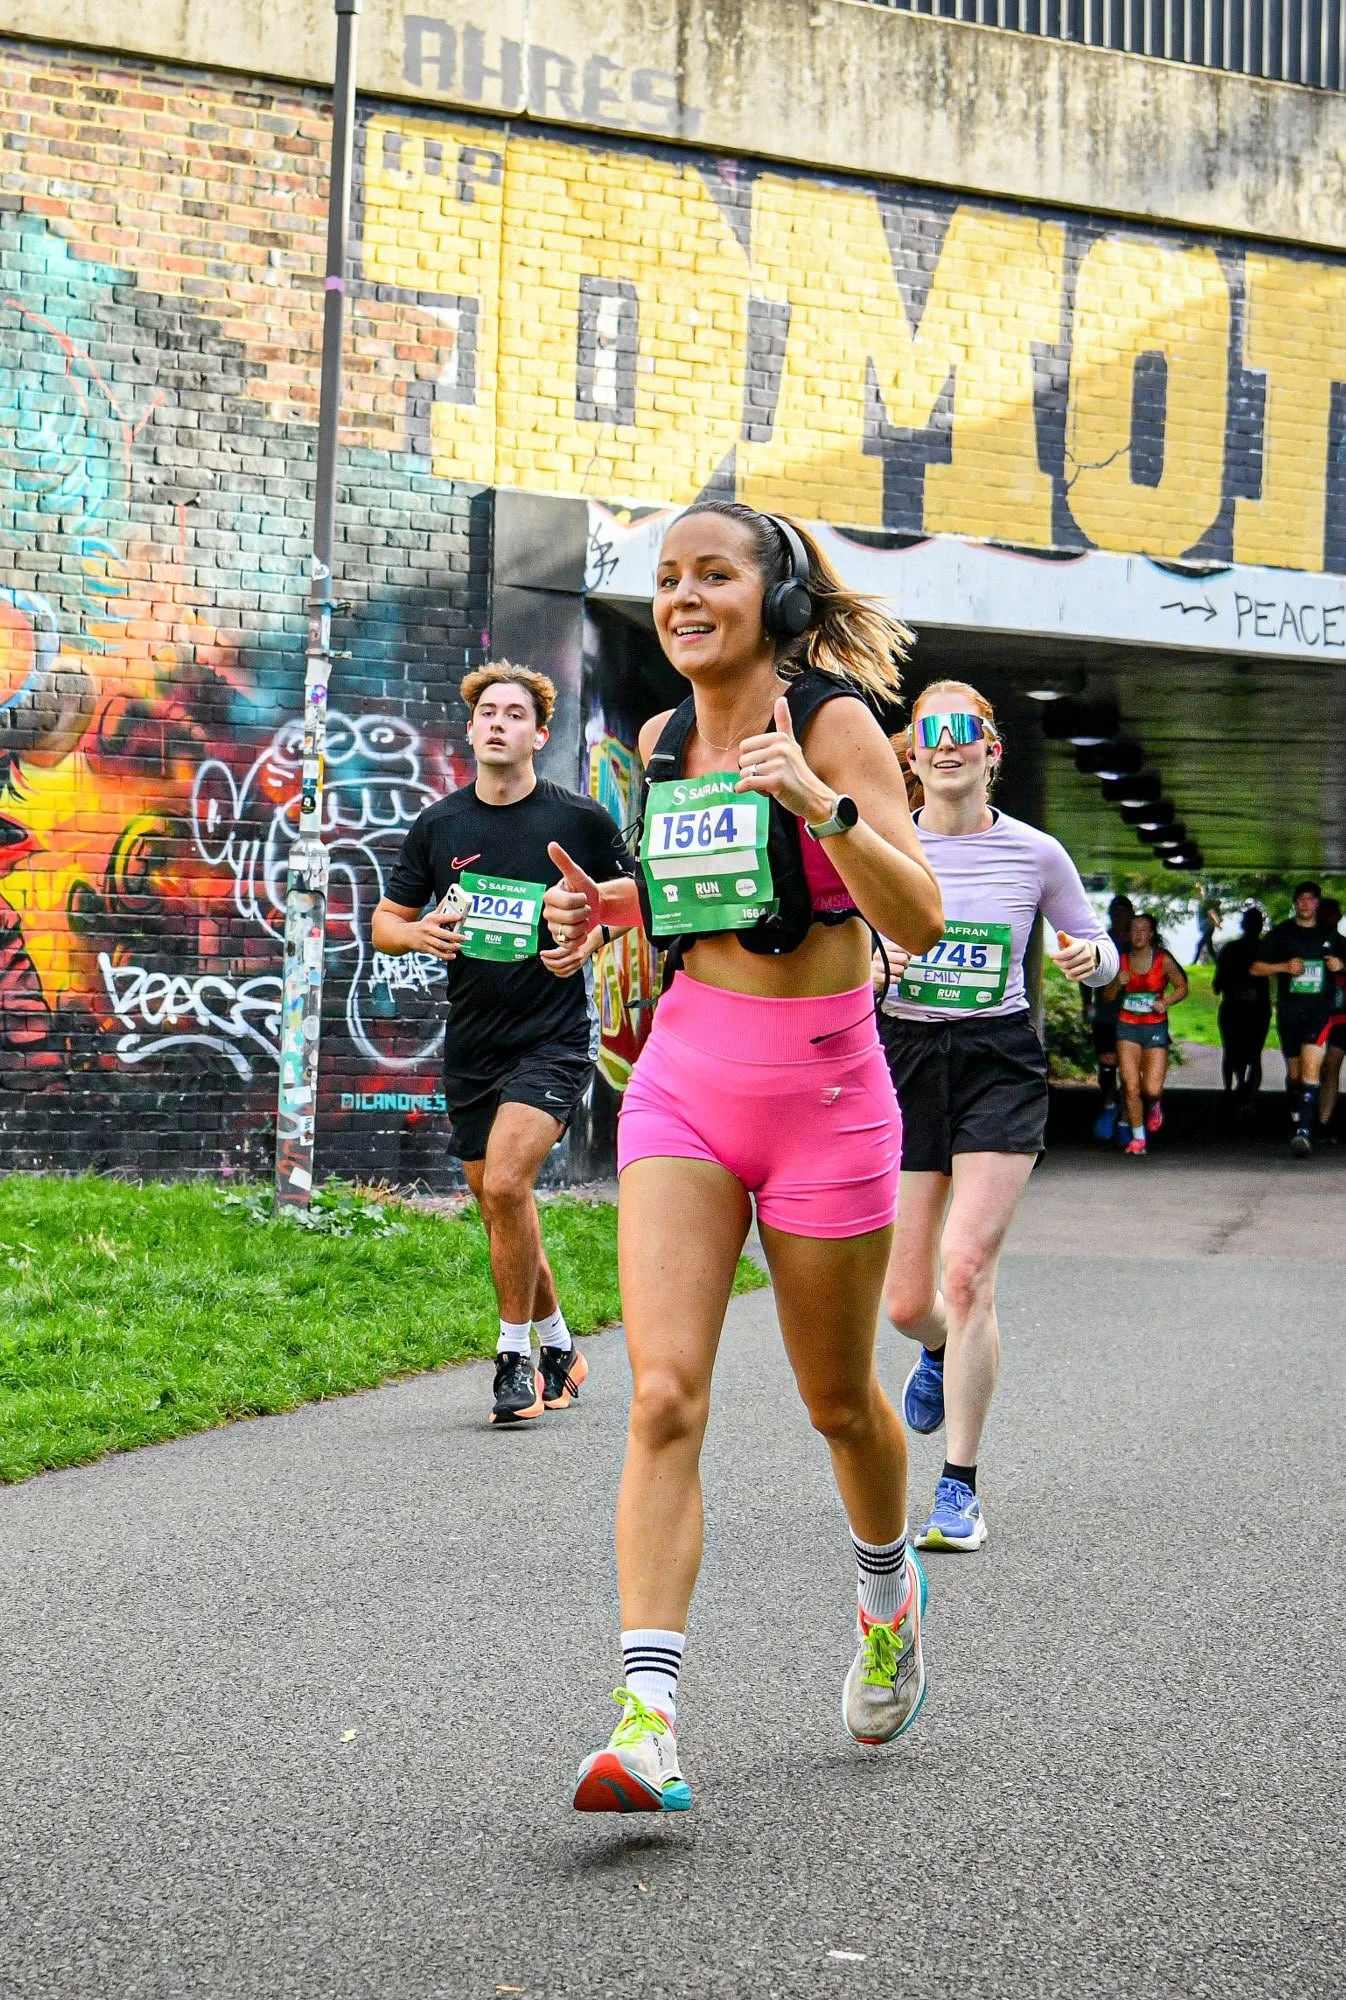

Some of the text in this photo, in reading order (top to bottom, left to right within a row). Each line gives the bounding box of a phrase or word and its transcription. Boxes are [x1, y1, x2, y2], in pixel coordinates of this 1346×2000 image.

[1234, 591, 1345, 646] PEACE
[688, 782, 734, 800] SAFRAN
[663, 808, 738, 850] 1564
[488, 882, 526, 894] SAFRAN
[695, 881, 720, 896] RUN
[472, 895, 524, 919] 1204
[485, 934, 502, 942] RUN
[924, 970, 962, 984] EMILY
[937, 988, 960, 998] RUN
